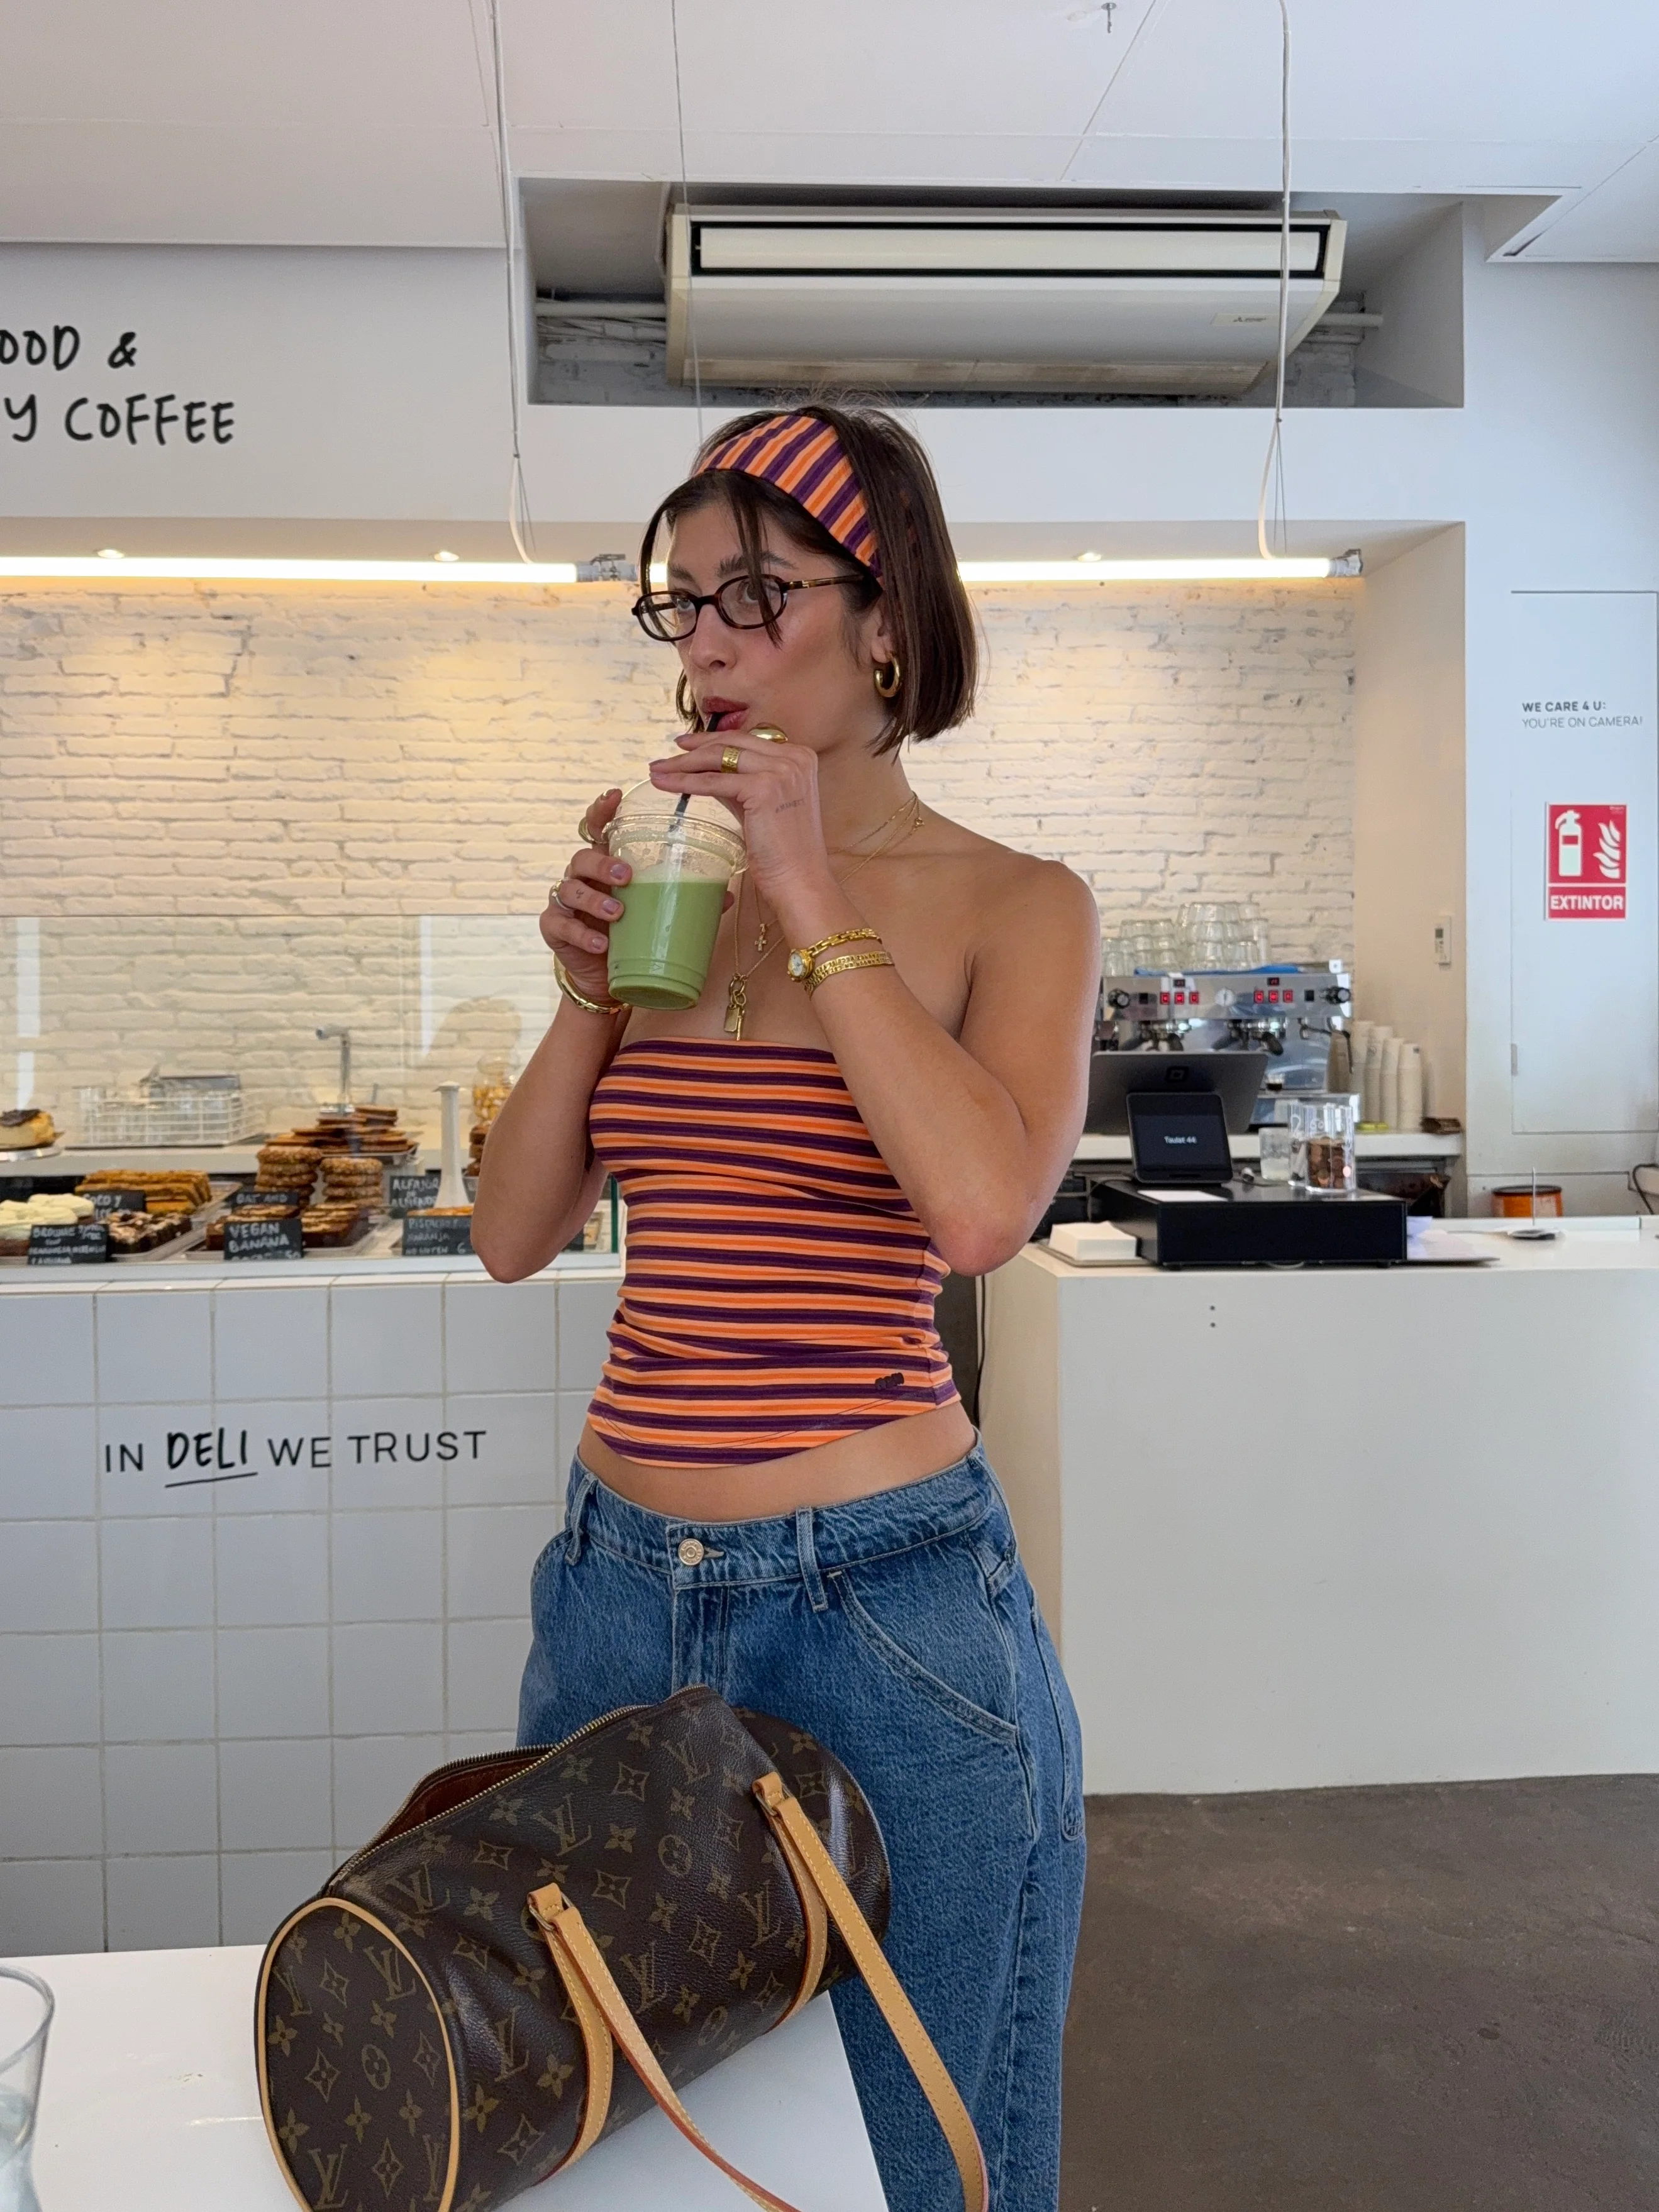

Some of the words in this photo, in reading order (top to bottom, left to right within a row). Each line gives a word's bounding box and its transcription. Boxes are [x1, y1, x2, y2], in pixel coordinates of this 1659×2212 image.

[0, 325, 80, 370] OOD
[108, 331, 136, 368] &
[65, 394, 234, 445] COFFEE
[1522, 702, 1541, 712] WE
[1545, 701, 1579, 712] CARE
[1582, 701, 1590, 711] 4
[1522, 717, 1565, 729] YOU'RE
[1568, 717, 1585, 728] ON
[1588, 716, 1643, 728] CAMERA!
[1550, 895, 1623, 910] EXTINTOR
[229, 1222, 280, 1238] VEGAN
[228, 1234, 289, 1253] BANANA
[105, 1444, 144, 1473] IN
[167, 1428, 248, 1470] DELI
[267, 1437, 331, 1468] WE
[347, 1430, 487, 1464] TRUST
